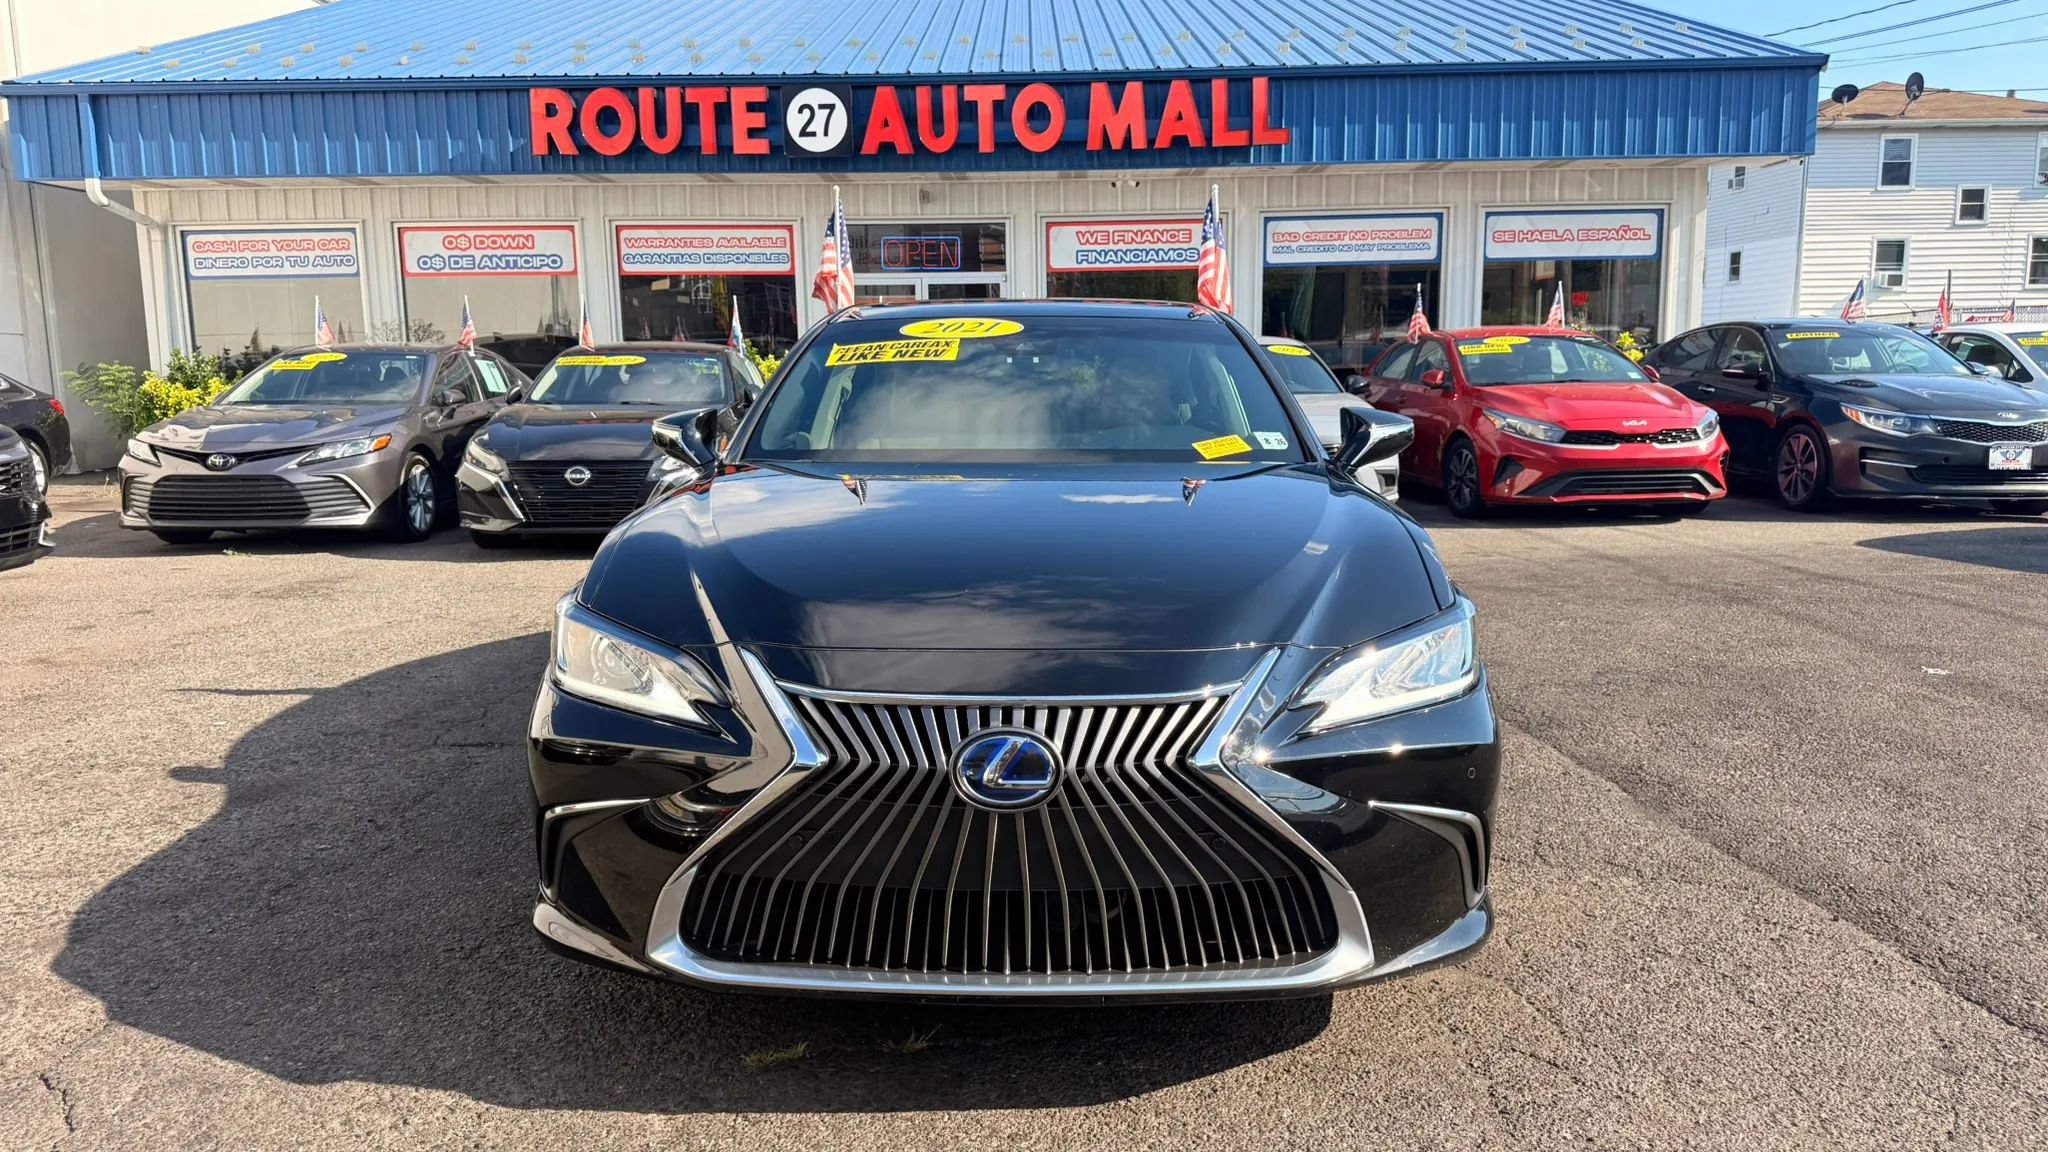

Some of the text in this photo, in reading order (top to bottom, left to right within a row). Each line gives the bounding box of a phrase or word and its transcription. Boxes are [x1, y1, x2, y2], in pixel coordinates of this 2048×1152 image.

[529, 76, 1291, 156] ROUTE 27 AUTO MALL
[1076, 228, 1192, 245] WE FINANCE
[1272, 228, 1433, 243] BAD CREDIT NO PROBLEM
[1492, 225, 1652, 243] SE HABLA ESPAÑOL
[192, 238, 350, 253] CASH FOR YOUR CAR
[474, 234, 536, 250] DOWN
[624, 236, 788, 249] WARRANTIES AVAILABLE
[1272, 244, 1295, 254] MAL
[1338, 243, 1353, 252] NO
[1354, 242, 1376, 252] HAY
[1377, 240, 1431, 251] PROBLEMA
[194, 254, 355, 269] DINERO POR TU AUTO
[448, 255, 476, 269] DE
[477, 253, 564, 269] ANTICIPO
[623, 252, 790, 265] GARANTIAS DISPONIBLES
[884, 240, 958, 268] OPEN
[1076, 247, 1200, 264] FINANCIAMOS
[922, 321, 1002, 335] 2021
[834, 340, 954, 354] CLEAN CARFAX
[836, 349, 947, 362] LIKE NEW
